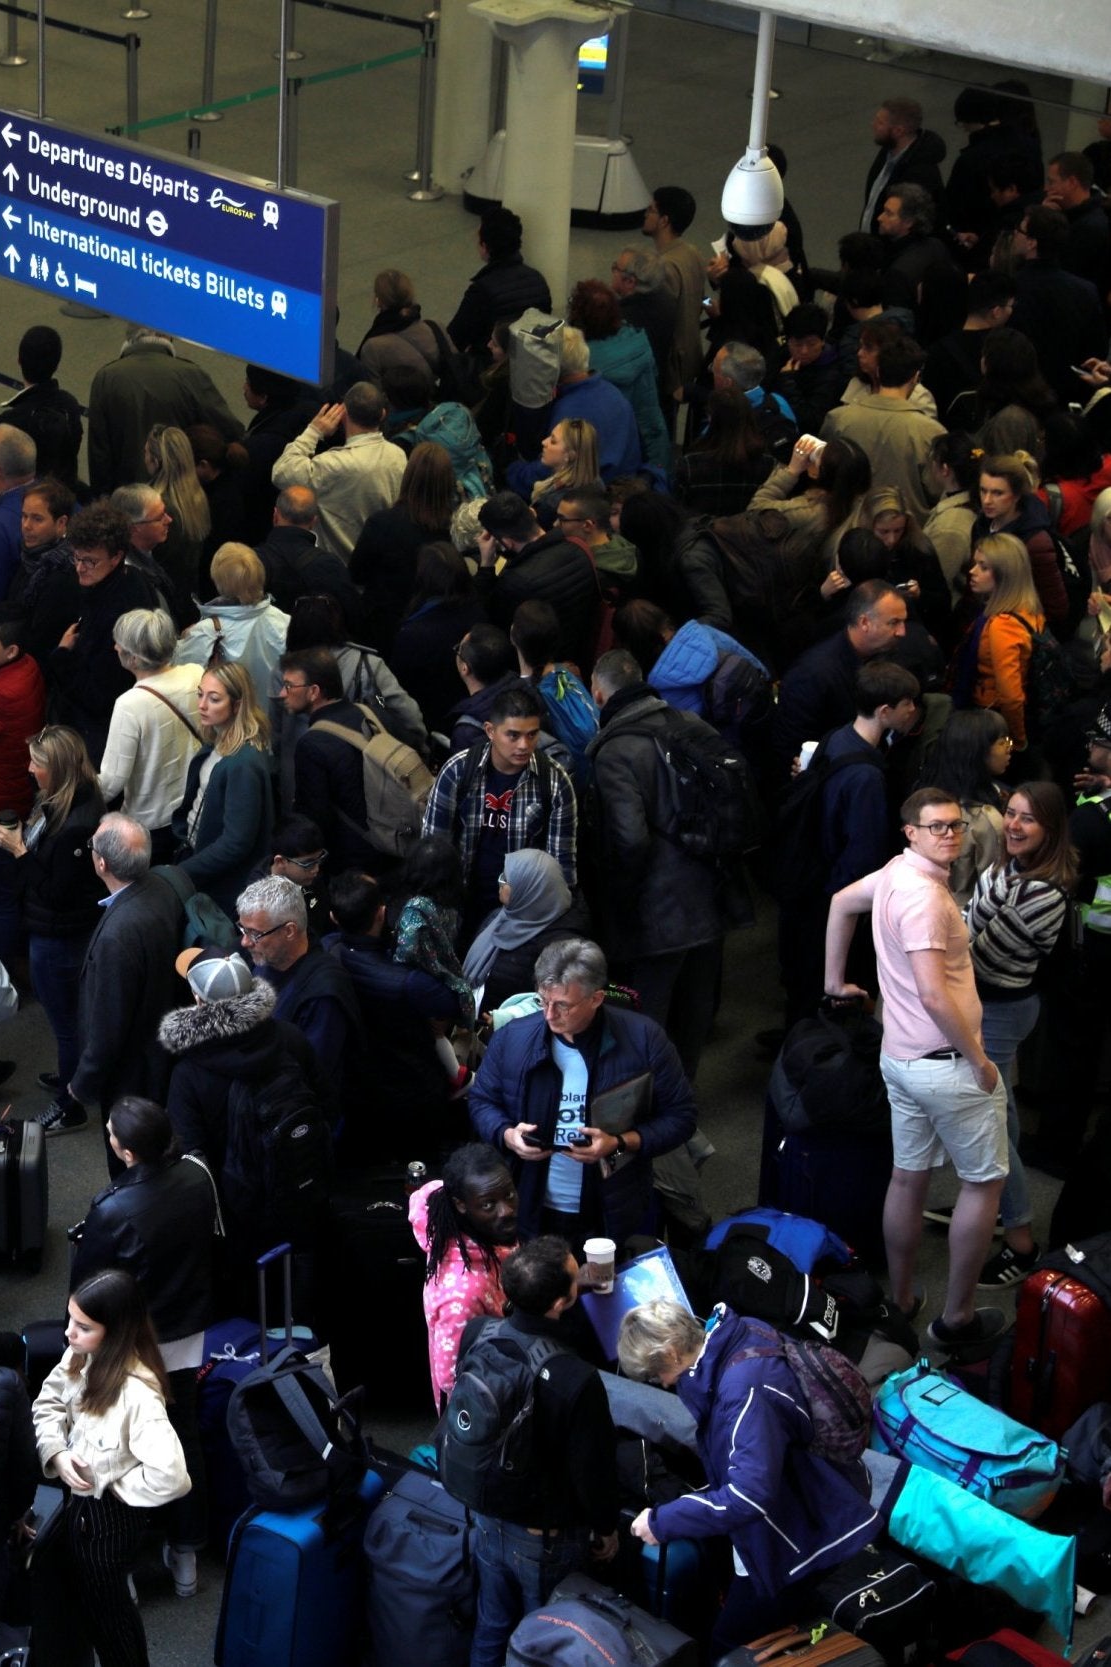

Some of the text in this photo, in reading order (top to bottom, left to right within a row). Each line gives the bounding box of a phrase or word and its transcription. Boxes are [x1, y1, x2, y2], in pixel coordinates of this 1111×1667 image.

[28, 130, 200, 203] Departures Départs
[28, 172, 141, 229] Underground
[221, 203, 256, 221] EUROSTAR
[28, 213, 265, 311] International tickets Billets
